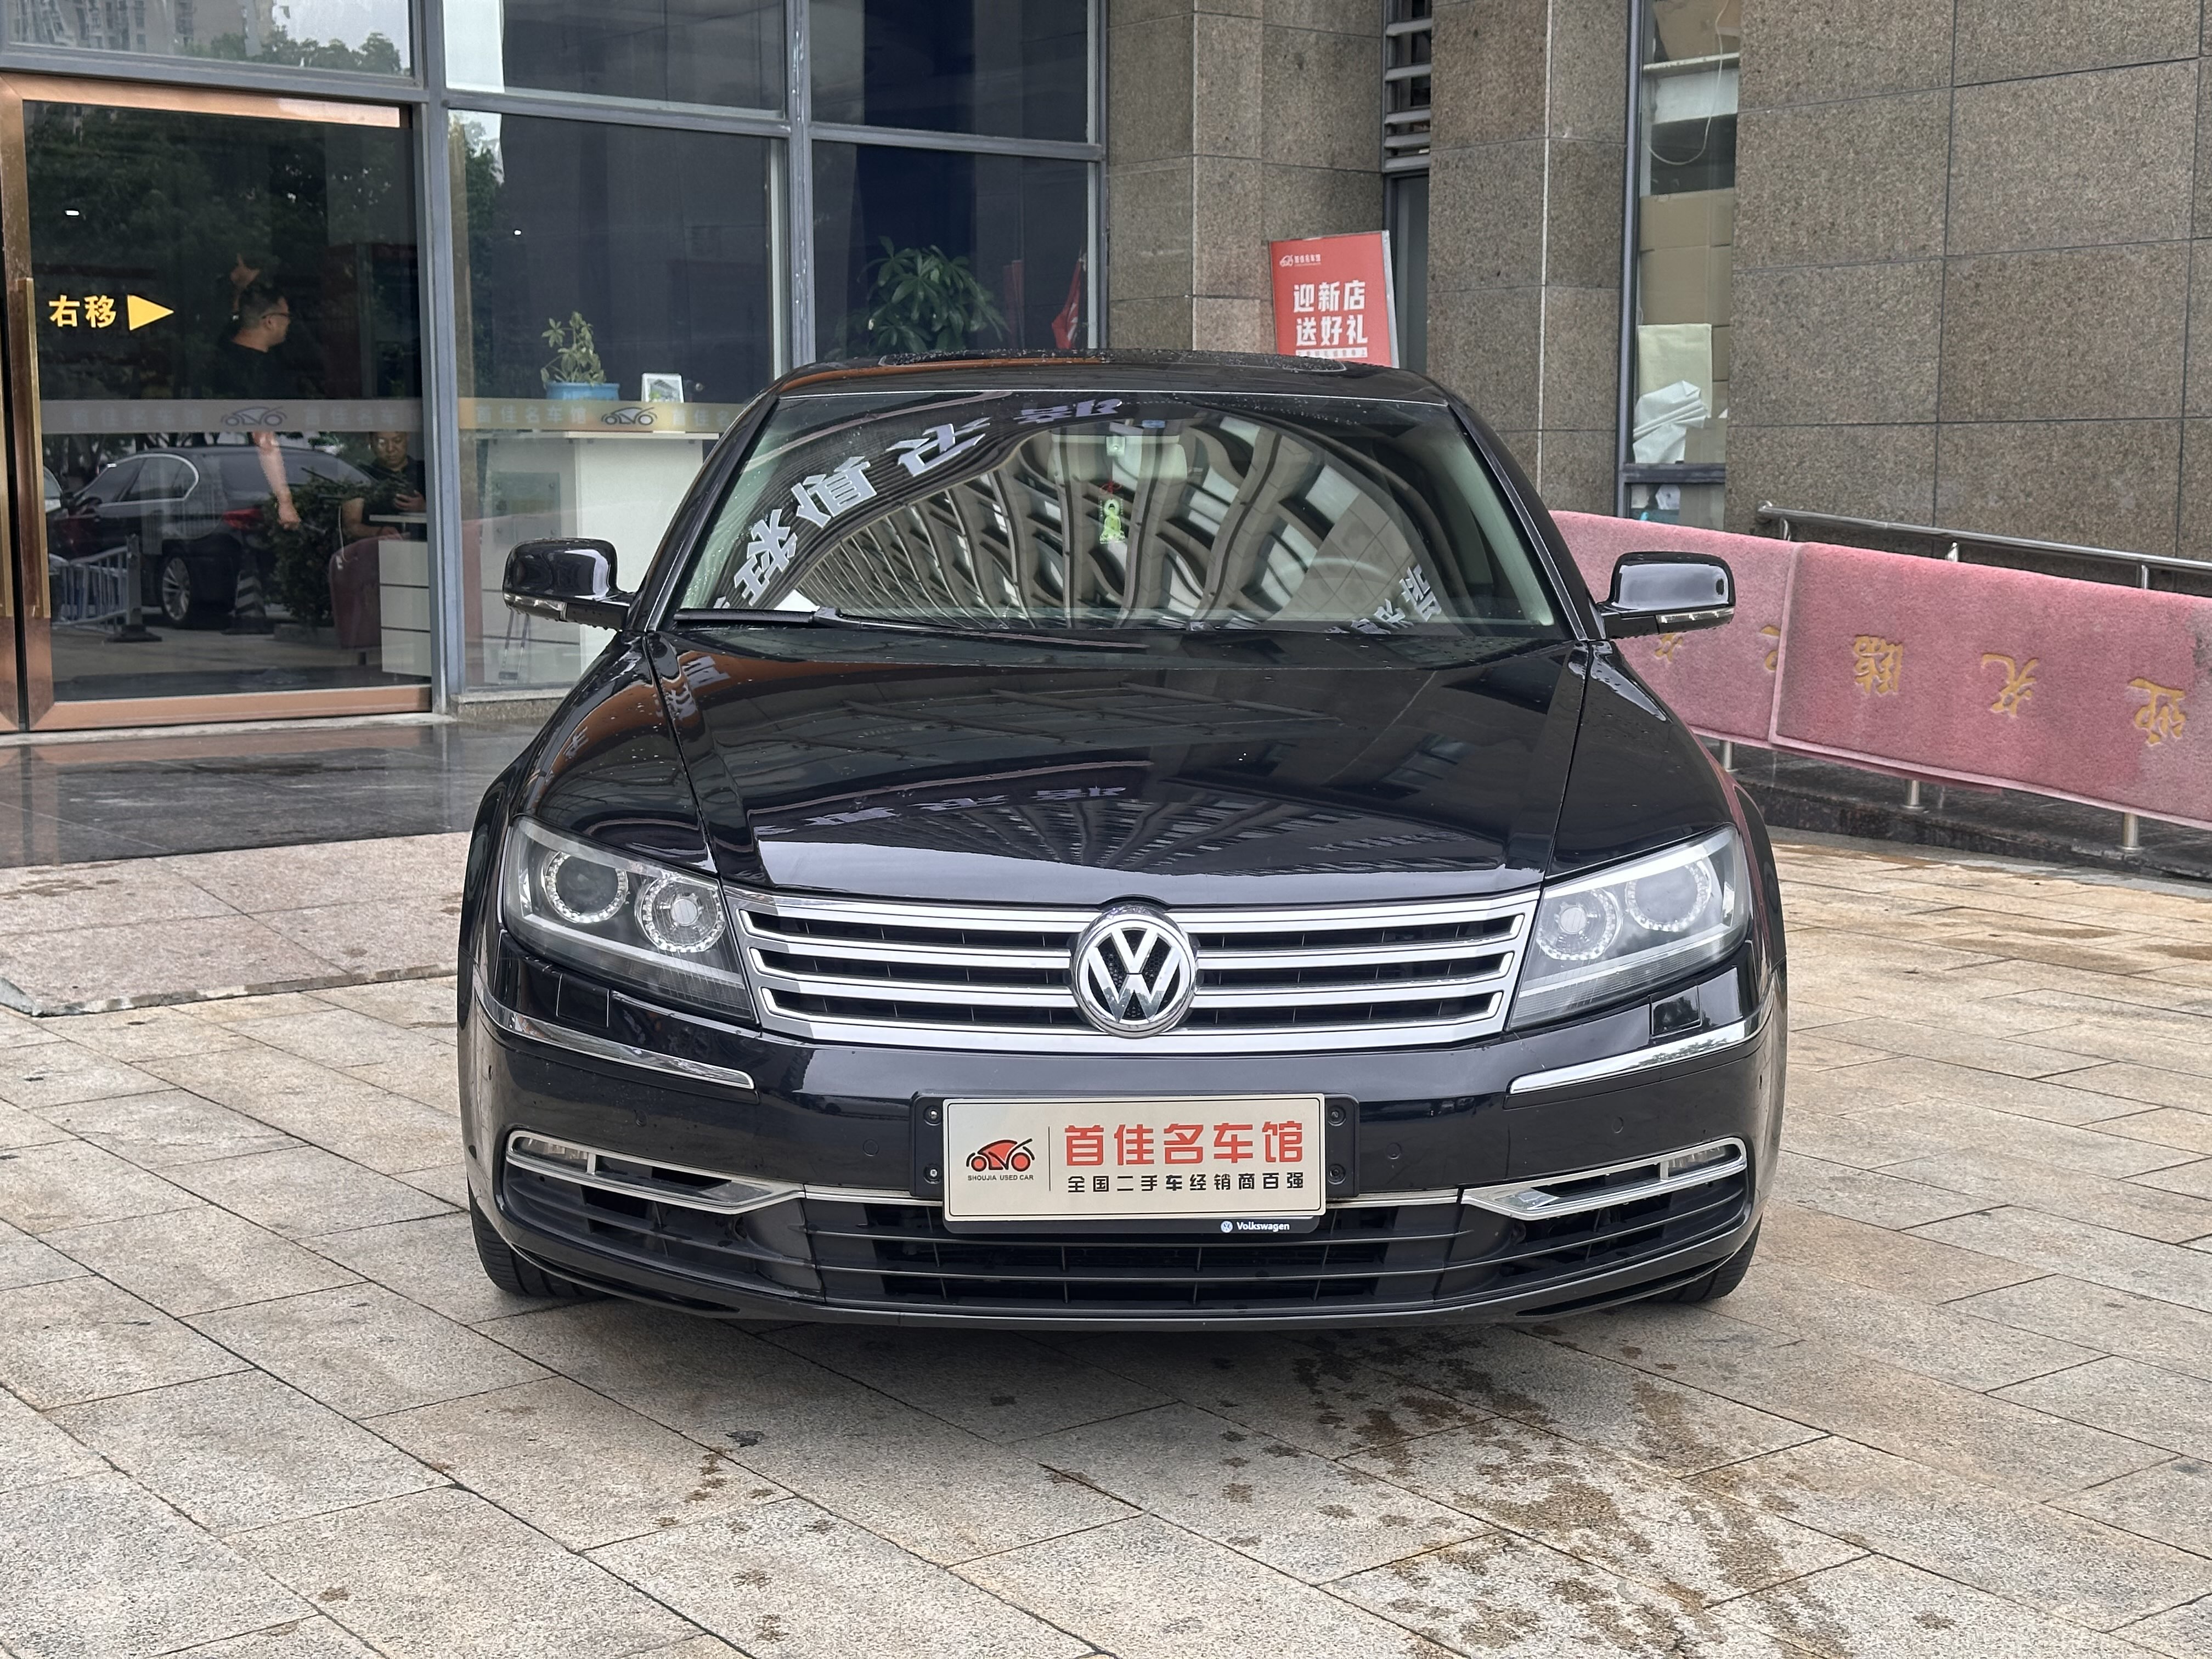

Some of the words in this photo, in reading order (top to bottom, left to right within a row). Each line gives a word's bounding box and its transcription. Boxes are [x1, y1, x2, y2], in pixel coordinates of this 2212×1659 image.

[49, 295, 116, 328] 右移
[1293, 280, 1365, 313] 迎新店
[1296, 314, 1368, 346] 送好礼
[1065, 1121, 1303, 1166] 首佳名车馆
[1068, 1172, 1304, 1193] 全国二手车经销商百强
[1237, 1222, 1290, 1232] Volkswagen
